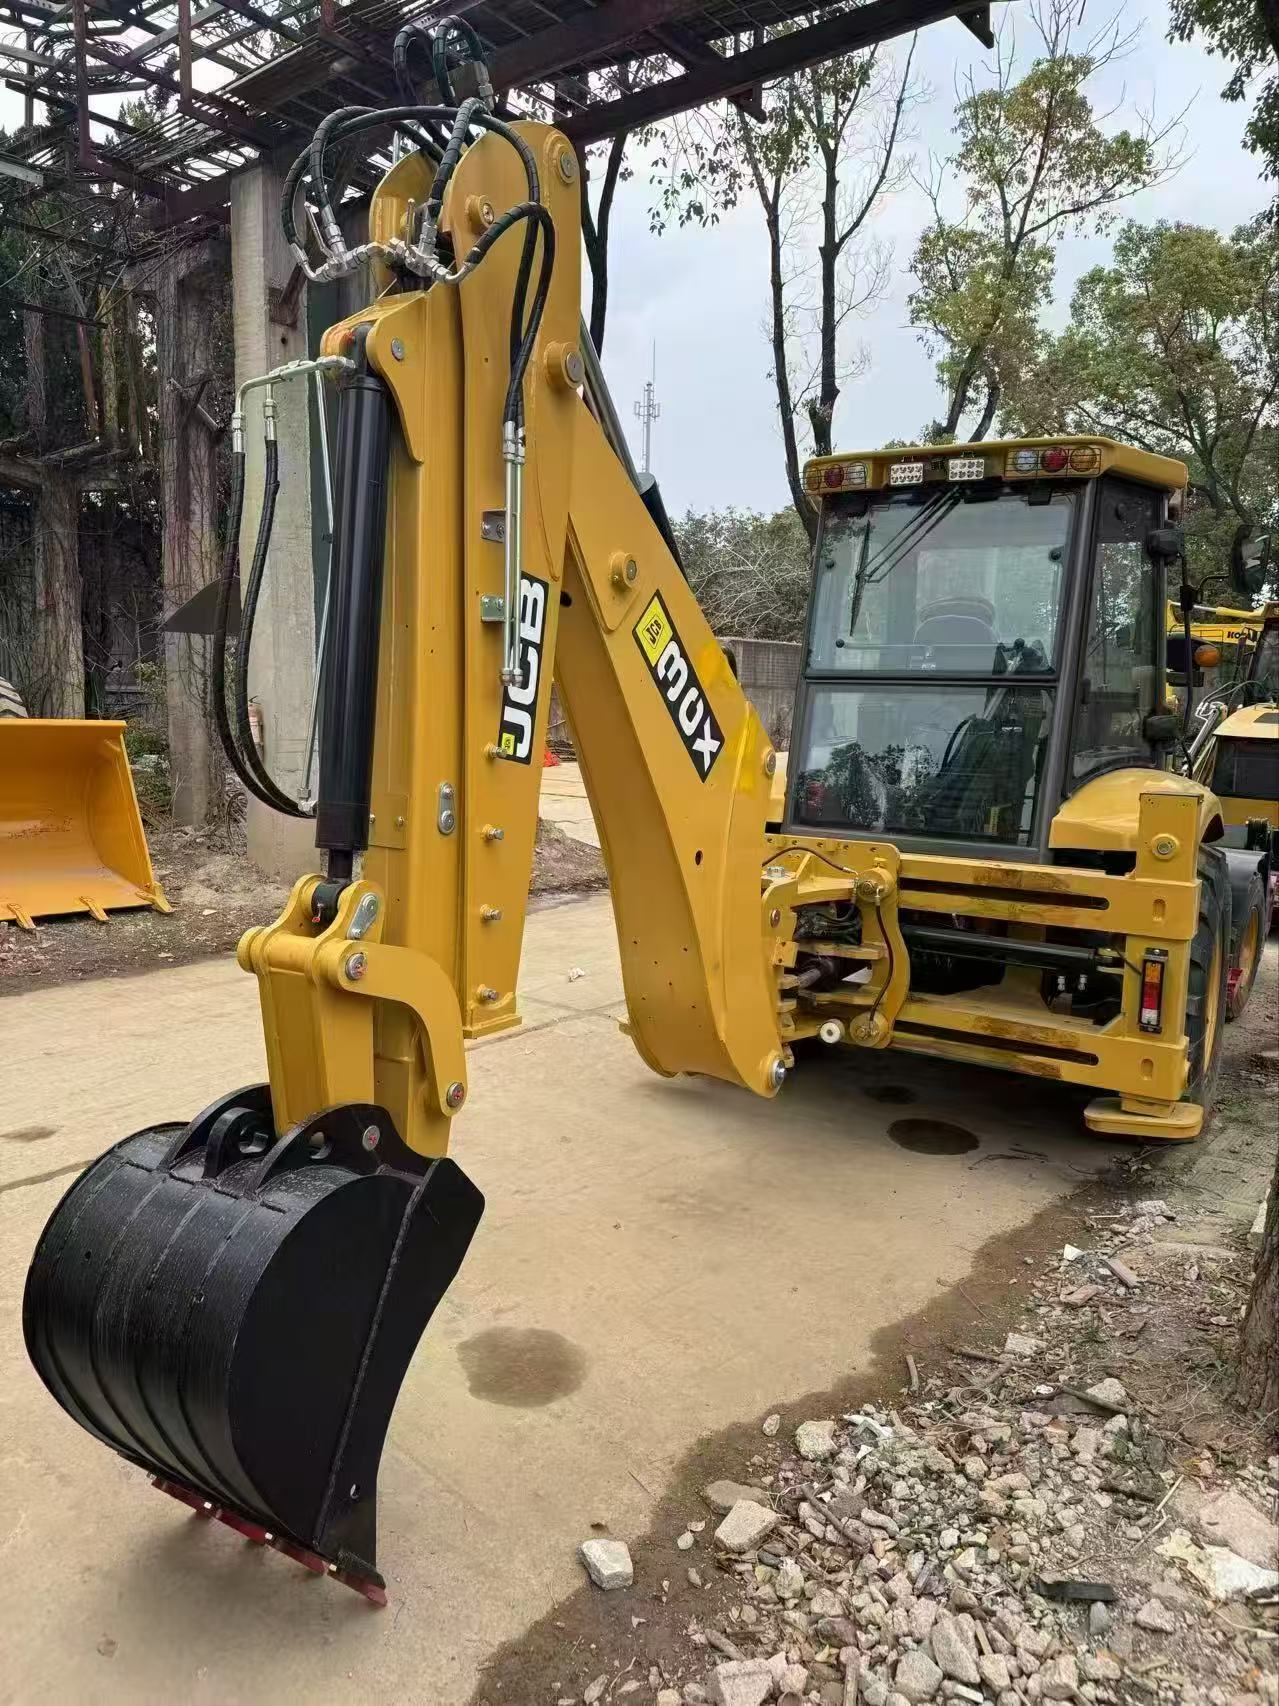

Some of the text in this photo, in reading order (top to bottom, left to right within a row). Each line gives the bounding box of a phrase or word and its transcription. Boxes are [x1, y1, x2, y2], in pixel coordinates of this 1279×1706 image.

[503, 578, 545, 758] JCB
[645, 619, 662, 645] JCB
[657, 640, 721, 773] 3CX
